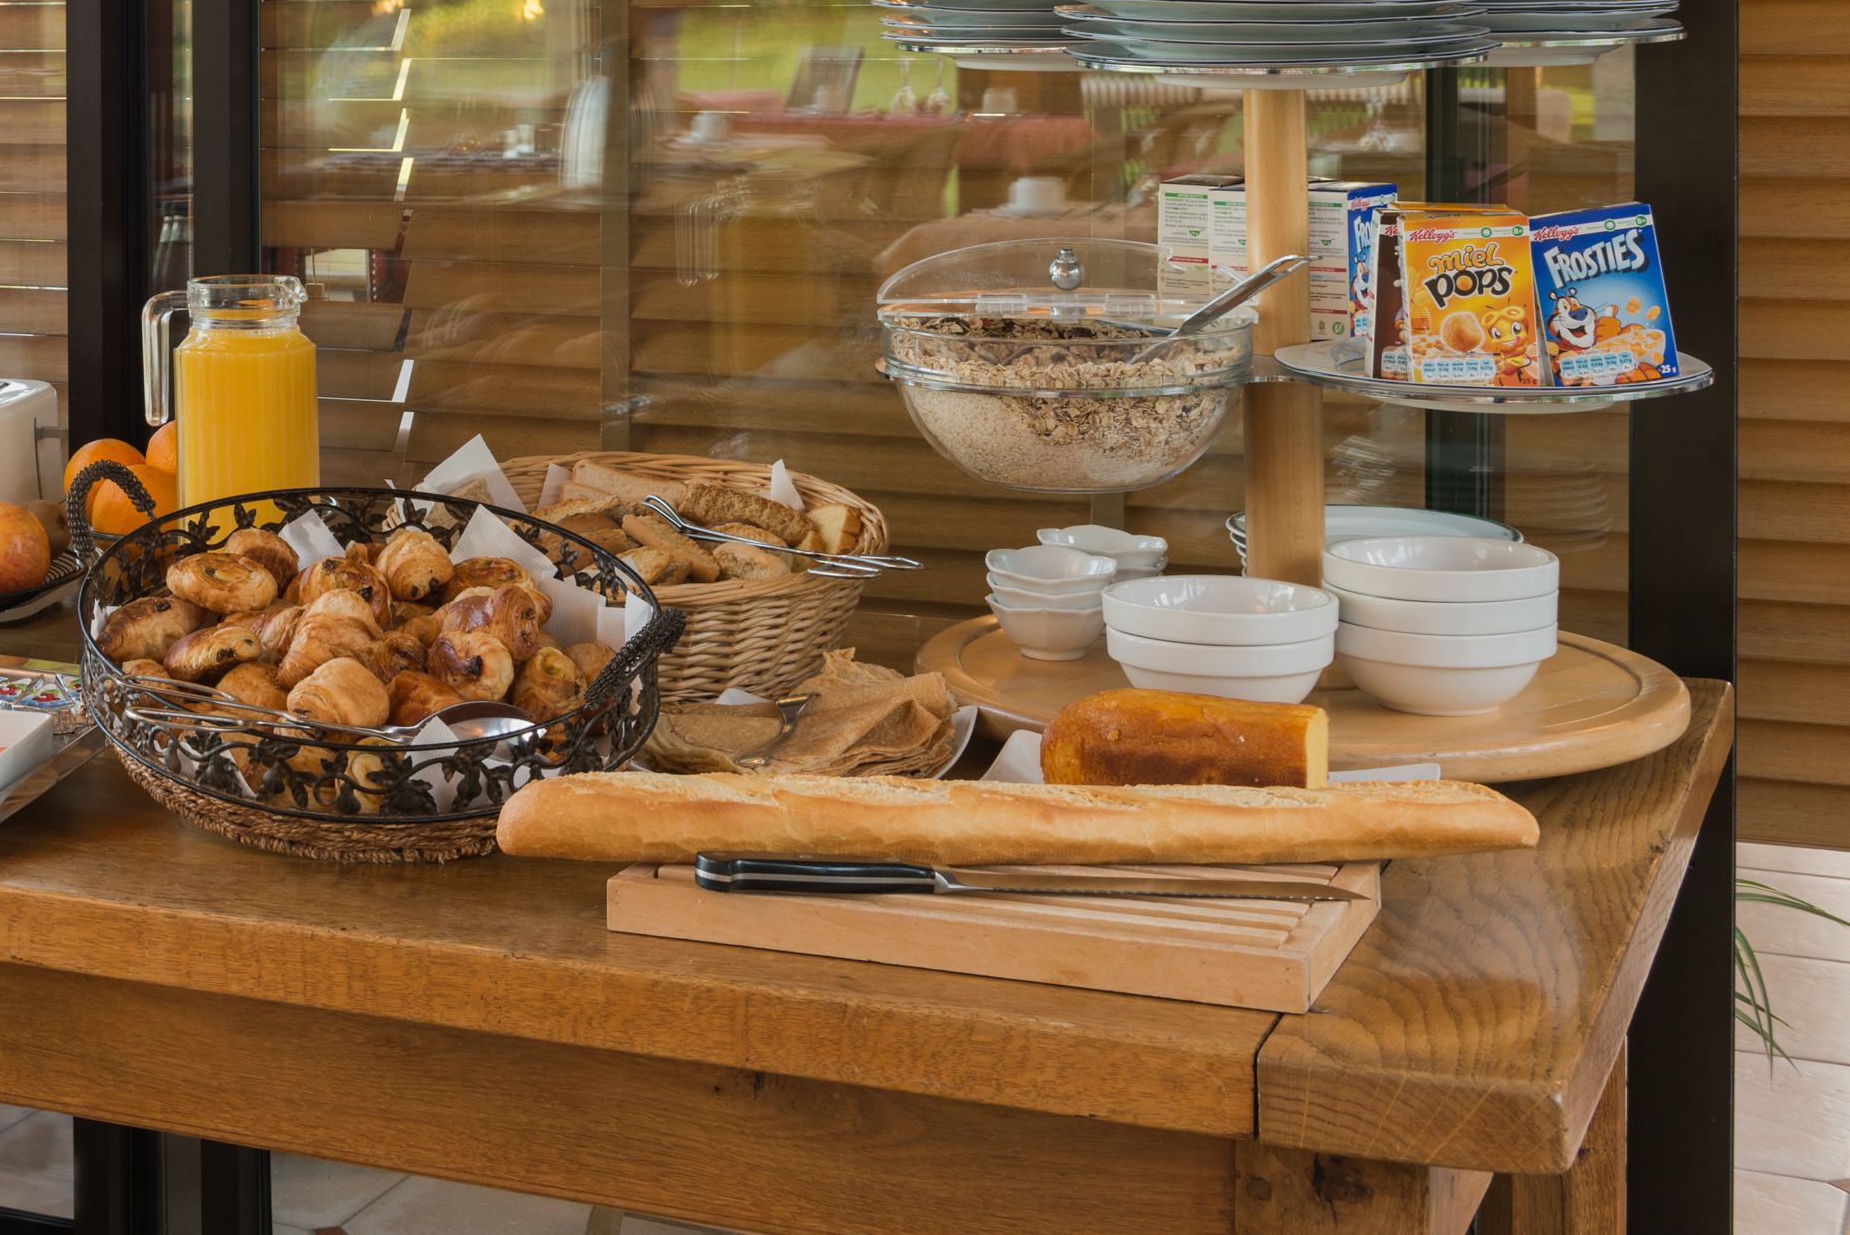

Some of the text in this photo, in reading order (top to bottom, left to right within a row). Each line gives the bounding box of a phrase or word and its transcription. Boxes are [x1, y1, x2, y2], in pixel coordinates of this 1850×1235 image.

[1410, 230, 1455, 243] Kellogg's
[1534, 225, 1579, 242] Kellogg's
[1543, 228, 1646, 289] FROSTIES
